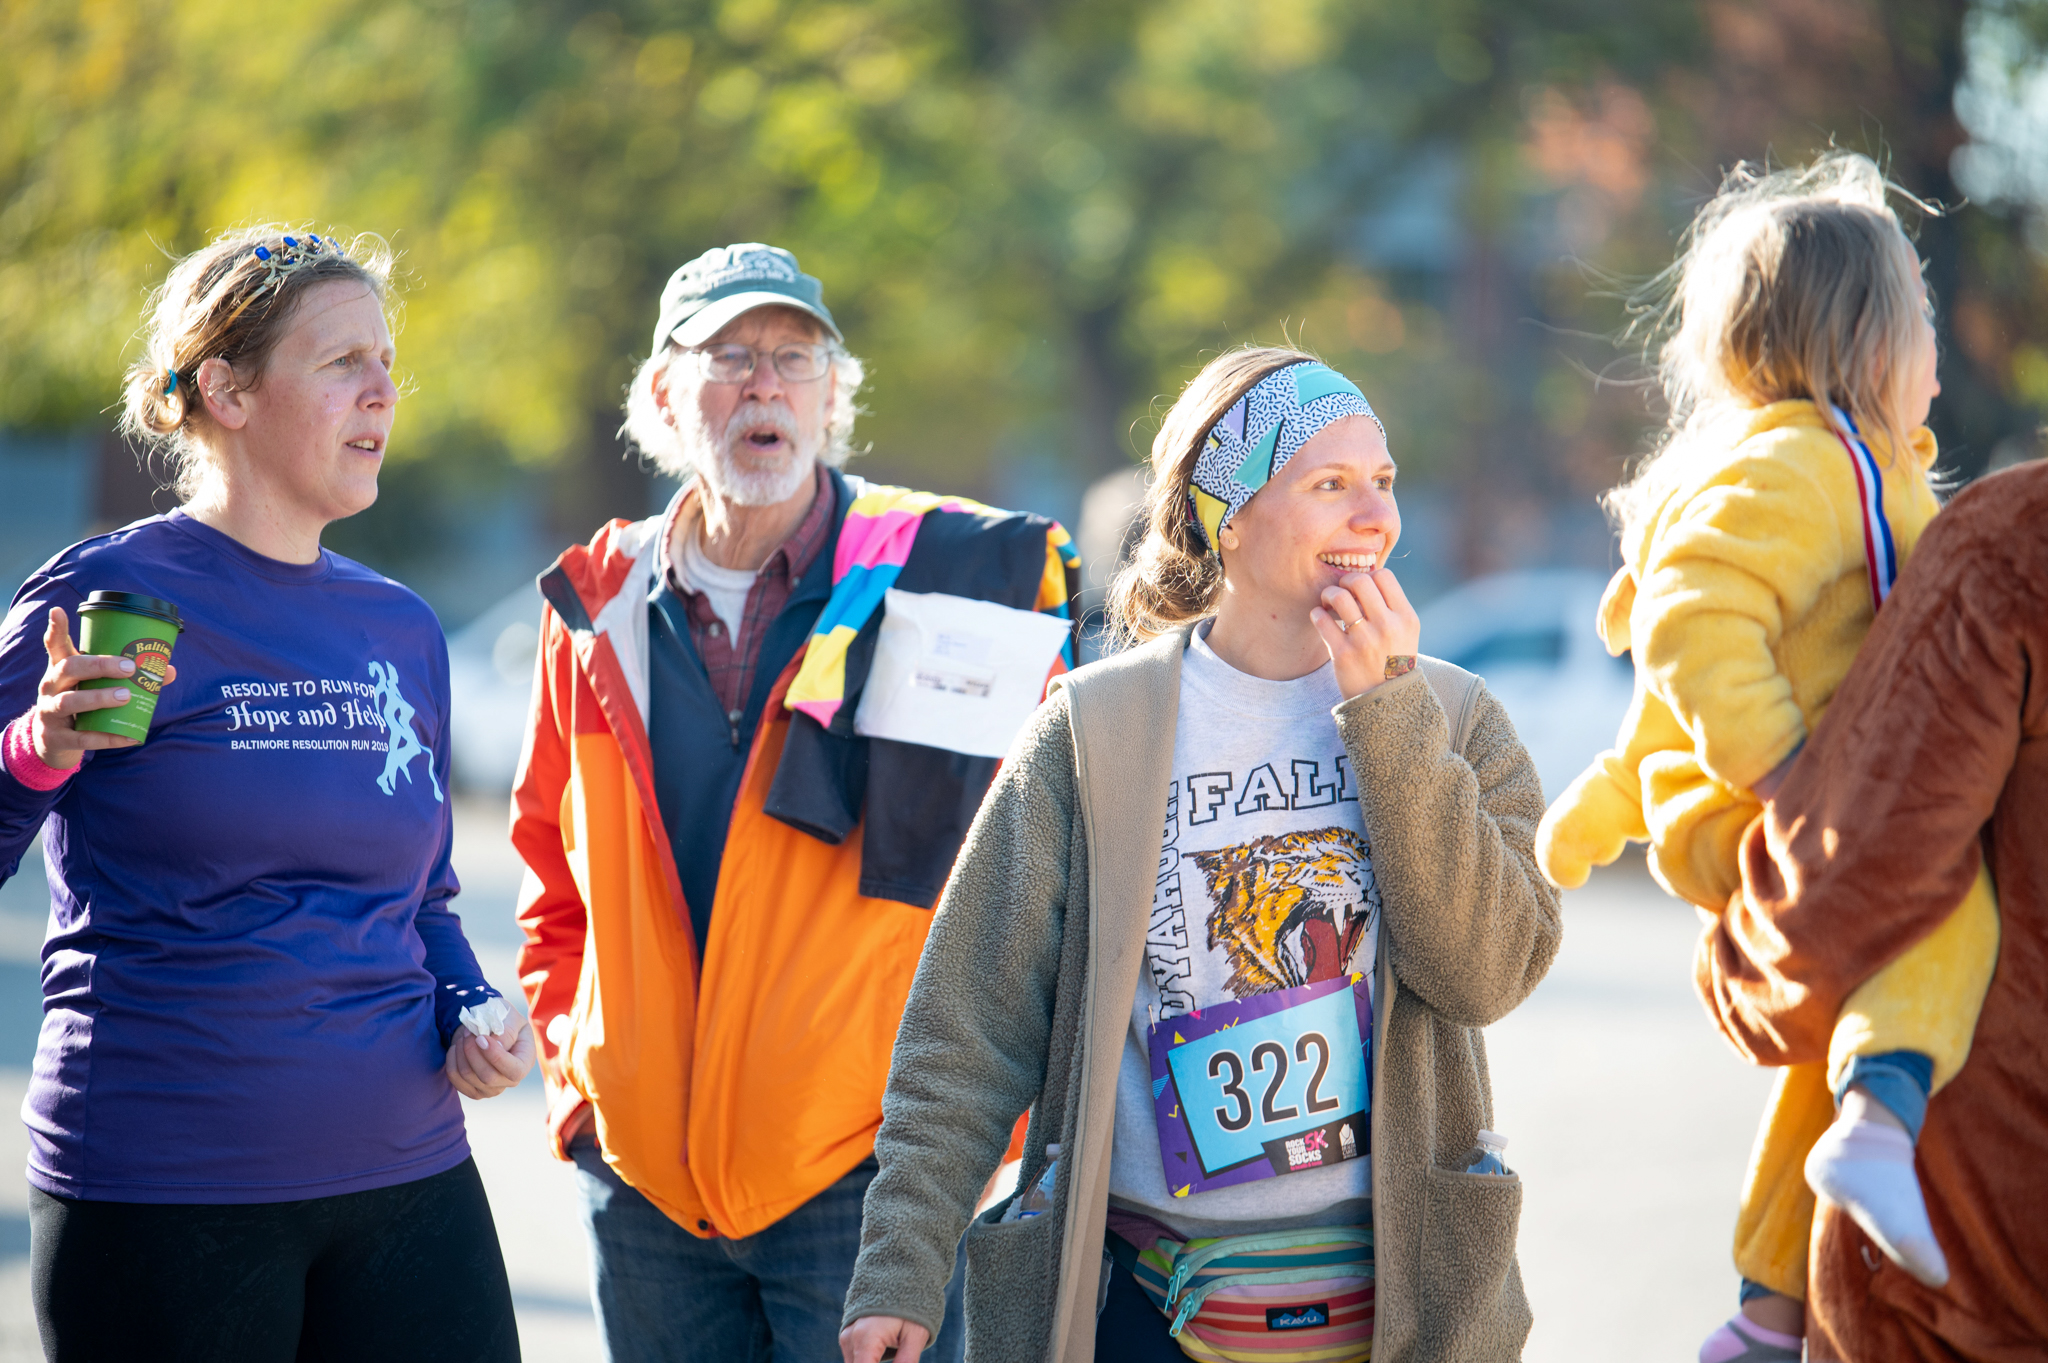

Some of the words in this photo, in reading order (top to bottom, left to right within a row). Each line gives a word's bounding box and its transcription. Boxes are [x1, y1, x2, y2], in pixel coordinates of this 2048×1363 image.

[221, 682, 289, 698] RESOLVE
[292, 681, 316, 697] TO
[321, 679, 352, 694] RUN
[353, 682, 376, 698] FOR
[225, 700, 292, 733] Hope
[297, 702, 337, 727] and
[341, 698, 387, 734] Help
[231, 740, 290, 750] BALTIMORE
[292, 740, 349, 750] RESOLUTION
[351, 740, 370, 750] RUN
[1207, 1031, 1340, 1133] 322
[1285, 1138, 1305, 1150] ROCK
[1304, 1128, 1329, 1151] 5K
[1287, 1145, 1307, 1156] YOUR
[1288, 1149, 1322, 1166] SOCKS
[1279, 1316, 1317, 1326] KAVU
